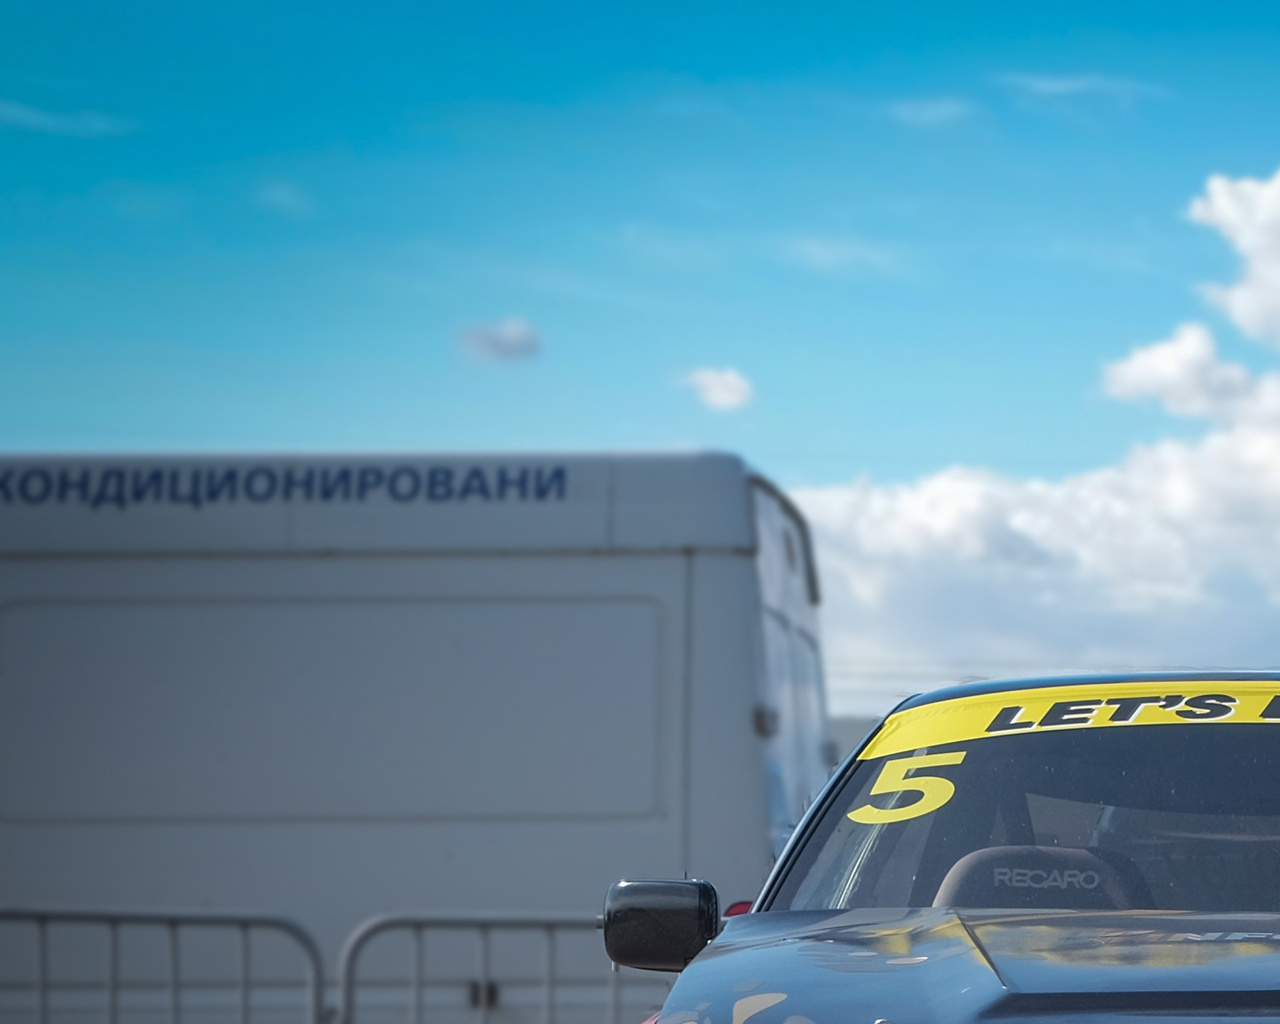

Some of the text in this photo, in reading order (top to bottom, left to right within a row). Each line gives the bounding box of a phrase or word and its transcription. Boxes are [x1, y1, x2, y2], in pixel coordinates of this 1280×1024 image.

[985, 694, 1238, 734] LET'S
[846, 750, 967, 825] 5
[993, 867, 1100, 890] RECARO
